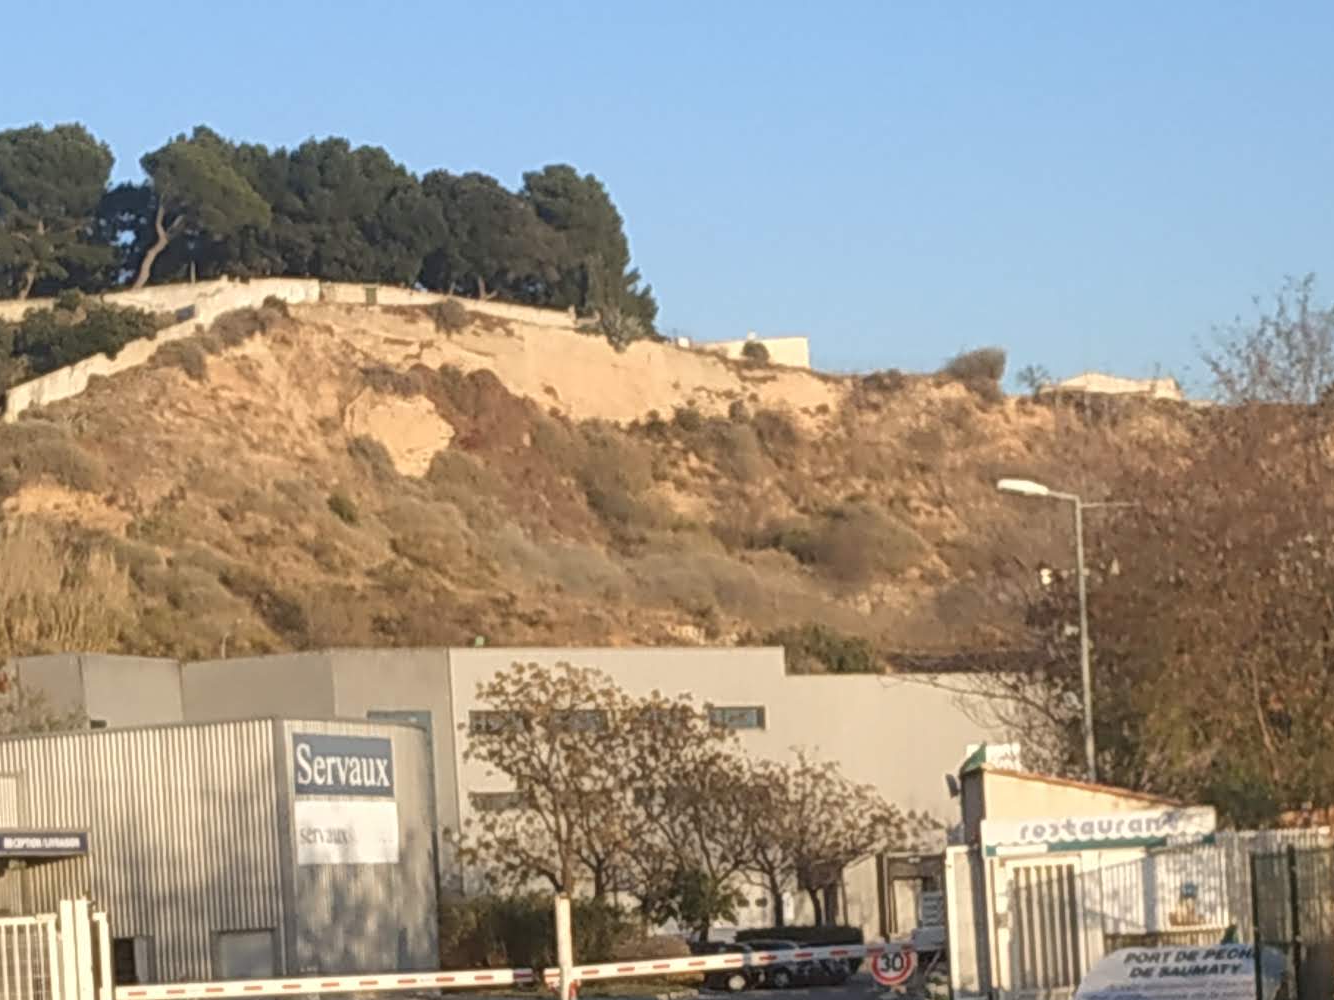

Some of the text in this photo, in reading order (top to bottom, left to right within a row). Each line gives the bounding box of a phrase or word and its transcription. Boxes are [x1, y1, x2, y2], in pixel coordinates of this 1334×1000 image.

[296, 743, 390, 787] Servaux
[880, 952, 904, 972] 30
[1124, 952, 1171, 965] PORT
[1175, 950, 1198, 962] DE
[1129, 966, 1154, 978] DE
